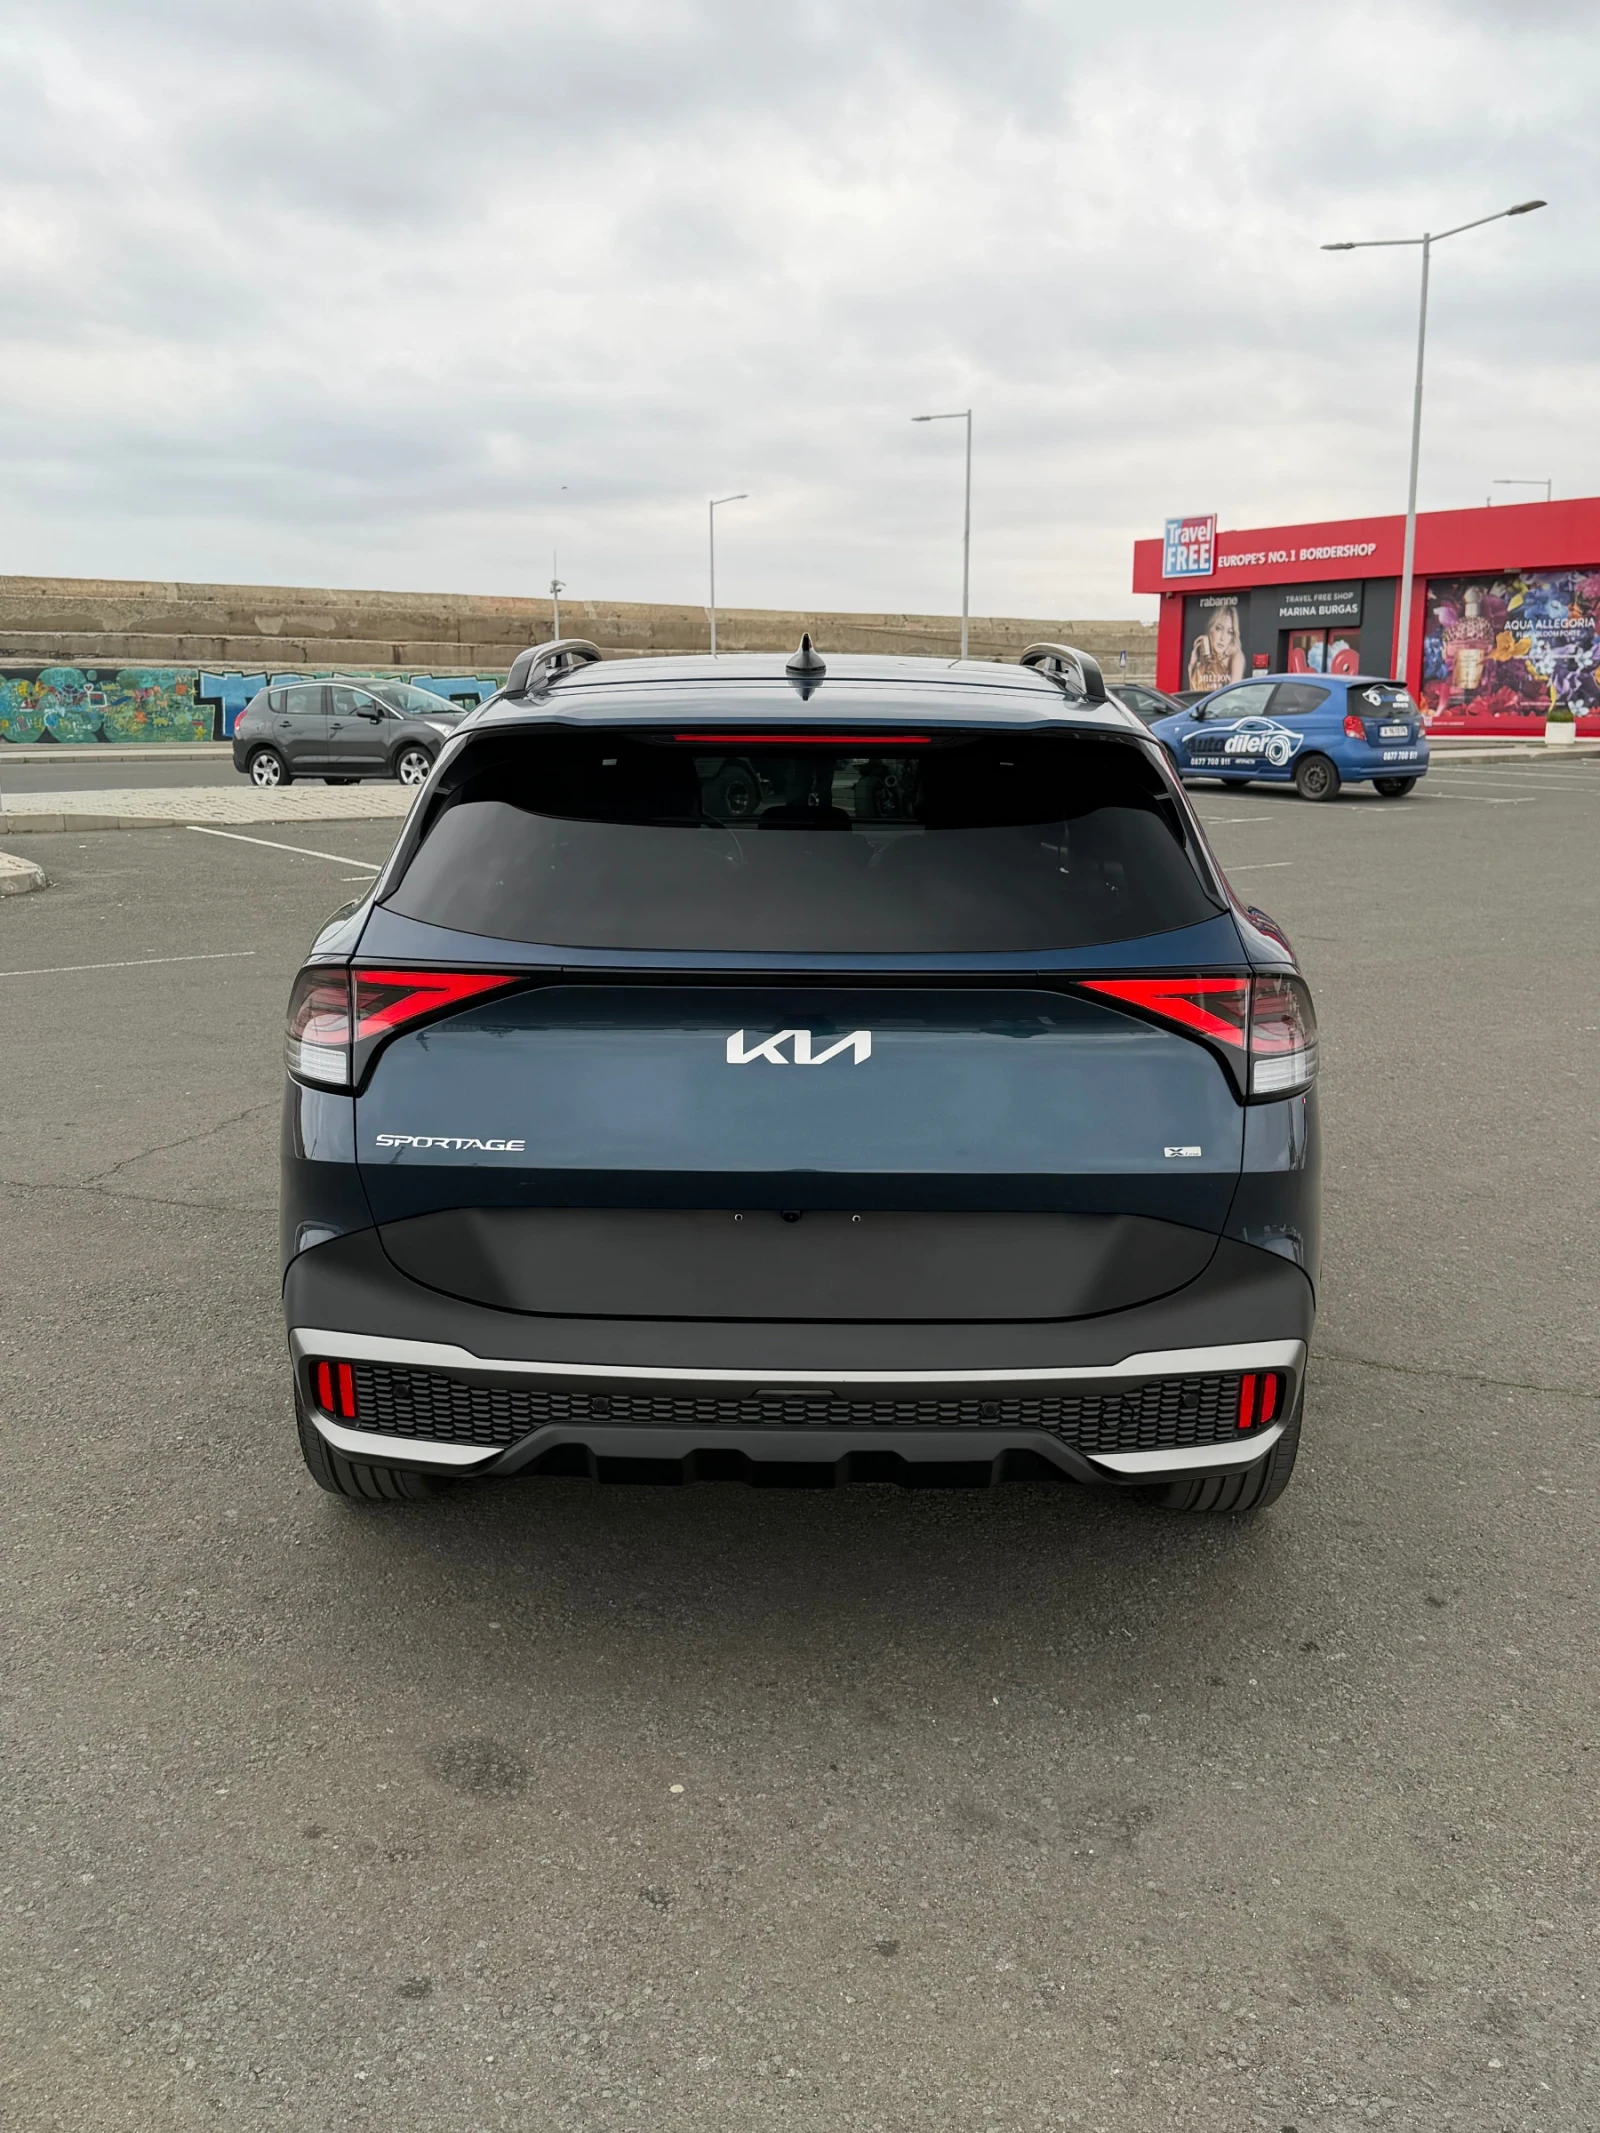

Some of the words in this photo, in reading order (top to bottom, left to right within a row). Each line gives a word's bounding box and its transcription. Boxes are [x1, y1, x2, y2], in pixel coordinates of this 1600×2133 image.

[1167, 518, 1212, 544] Travel
[1166, 543, 1210, 571] FREE
[1218, 552, 1265, 568] EUROPE'S
[1300, 543, 1376, 560] BORDERSHOP
[1200, 596, 1238, 607] rabanne
[1286, 595, 1312, 603] TRAVEL
[1313, 593, 1332, 602] FREE
[1333, 592, 1354, 601] SHOP
[1279, 606, 1316, 617] MARINA
[1318, 604, 1358, 615] BURGAS
[1504, 620, 1534, 630] AQUA
[1535, 617, 1595, 629] ALLEGORIA
[727, 1029, 871, 1065] KIA
[376, 1134, 525, 1151] SPORTAGE
